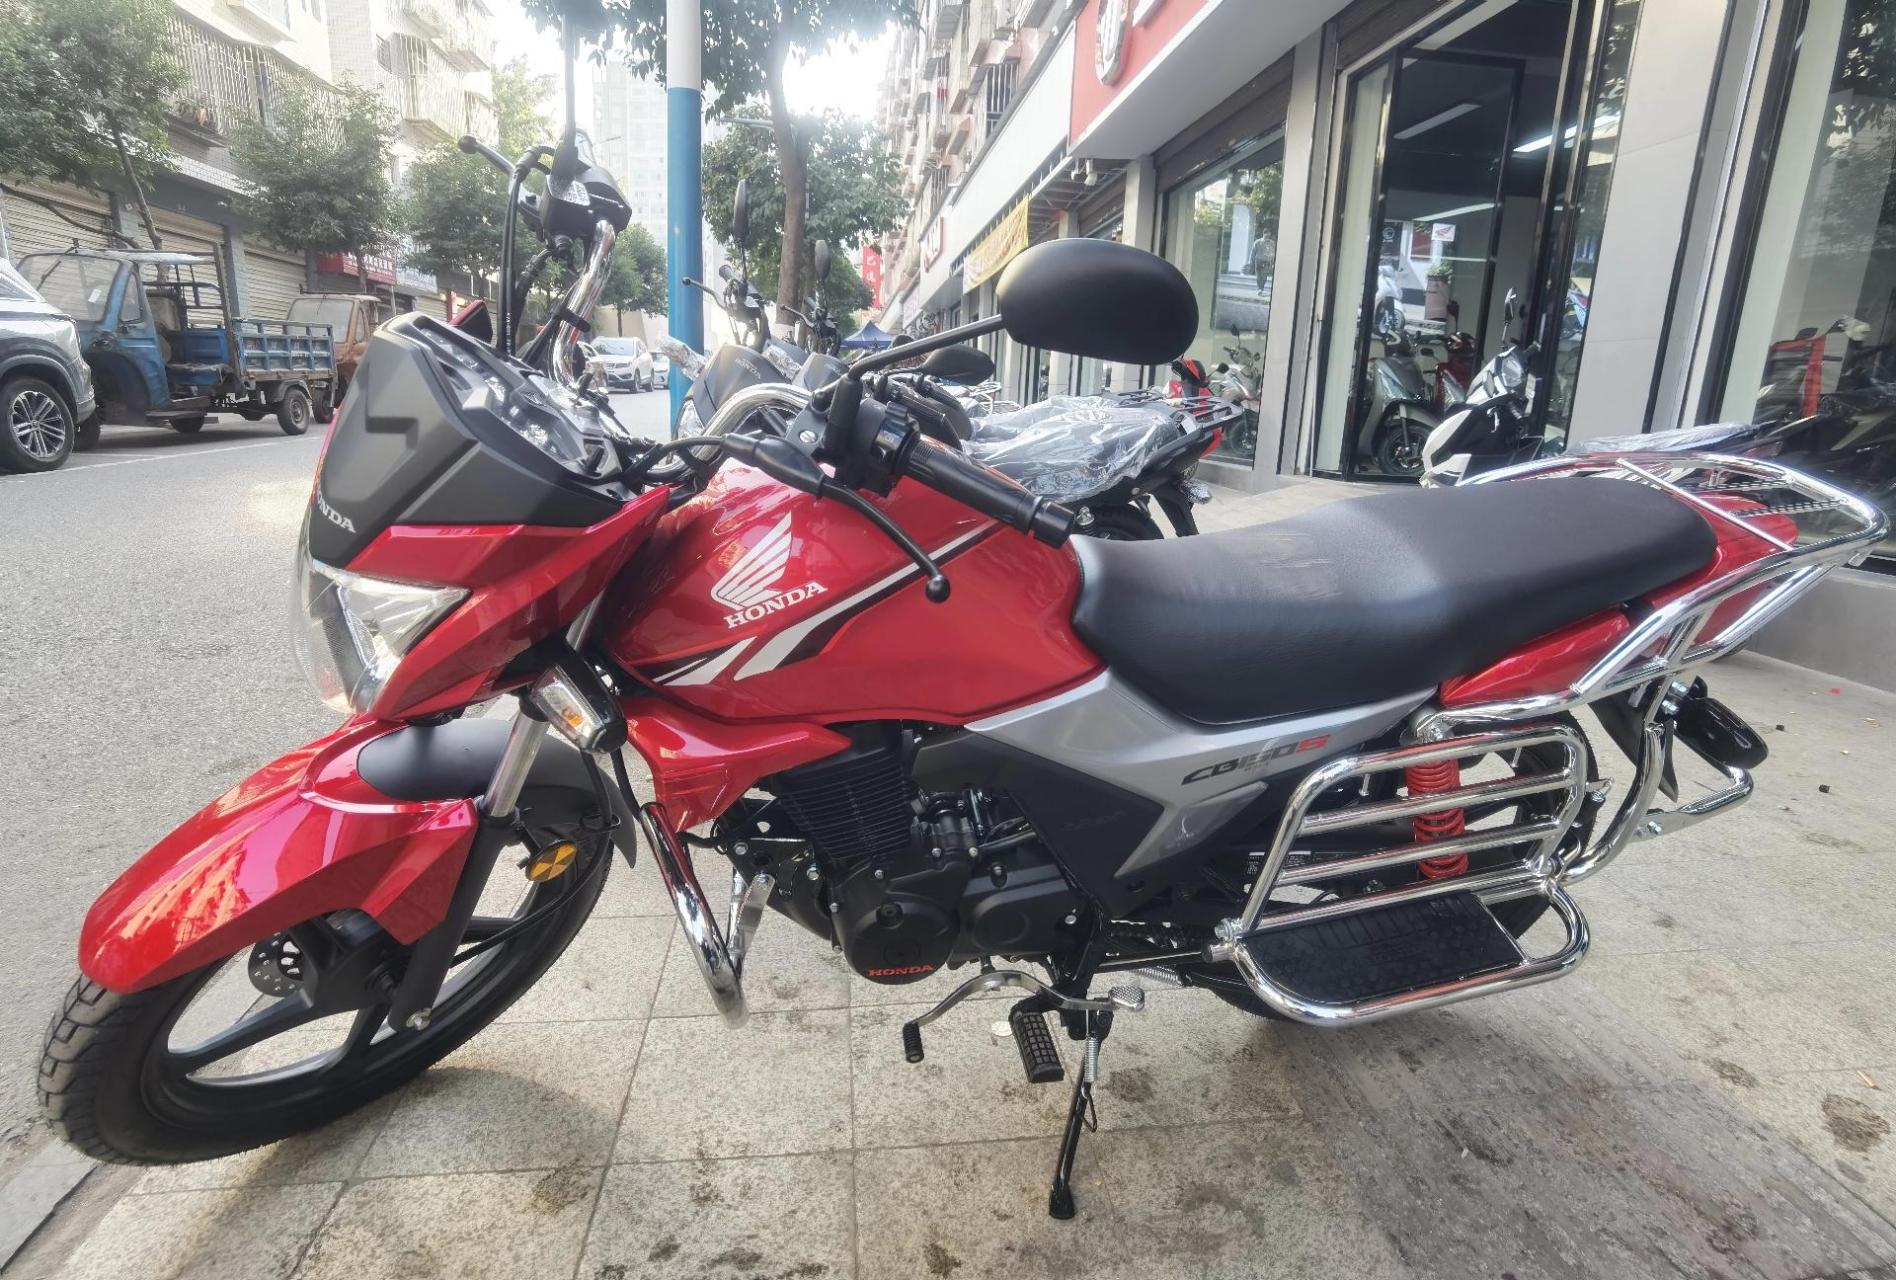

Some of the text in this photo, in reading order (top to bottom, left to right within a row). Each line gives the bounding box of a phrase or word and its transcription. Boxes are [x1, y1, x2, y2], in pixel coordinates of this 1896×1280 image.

[317, 488, 357, 534] ONDA
[724, 581, 828, 629] HONDA
[868, 964, 935, 976] HONDA
